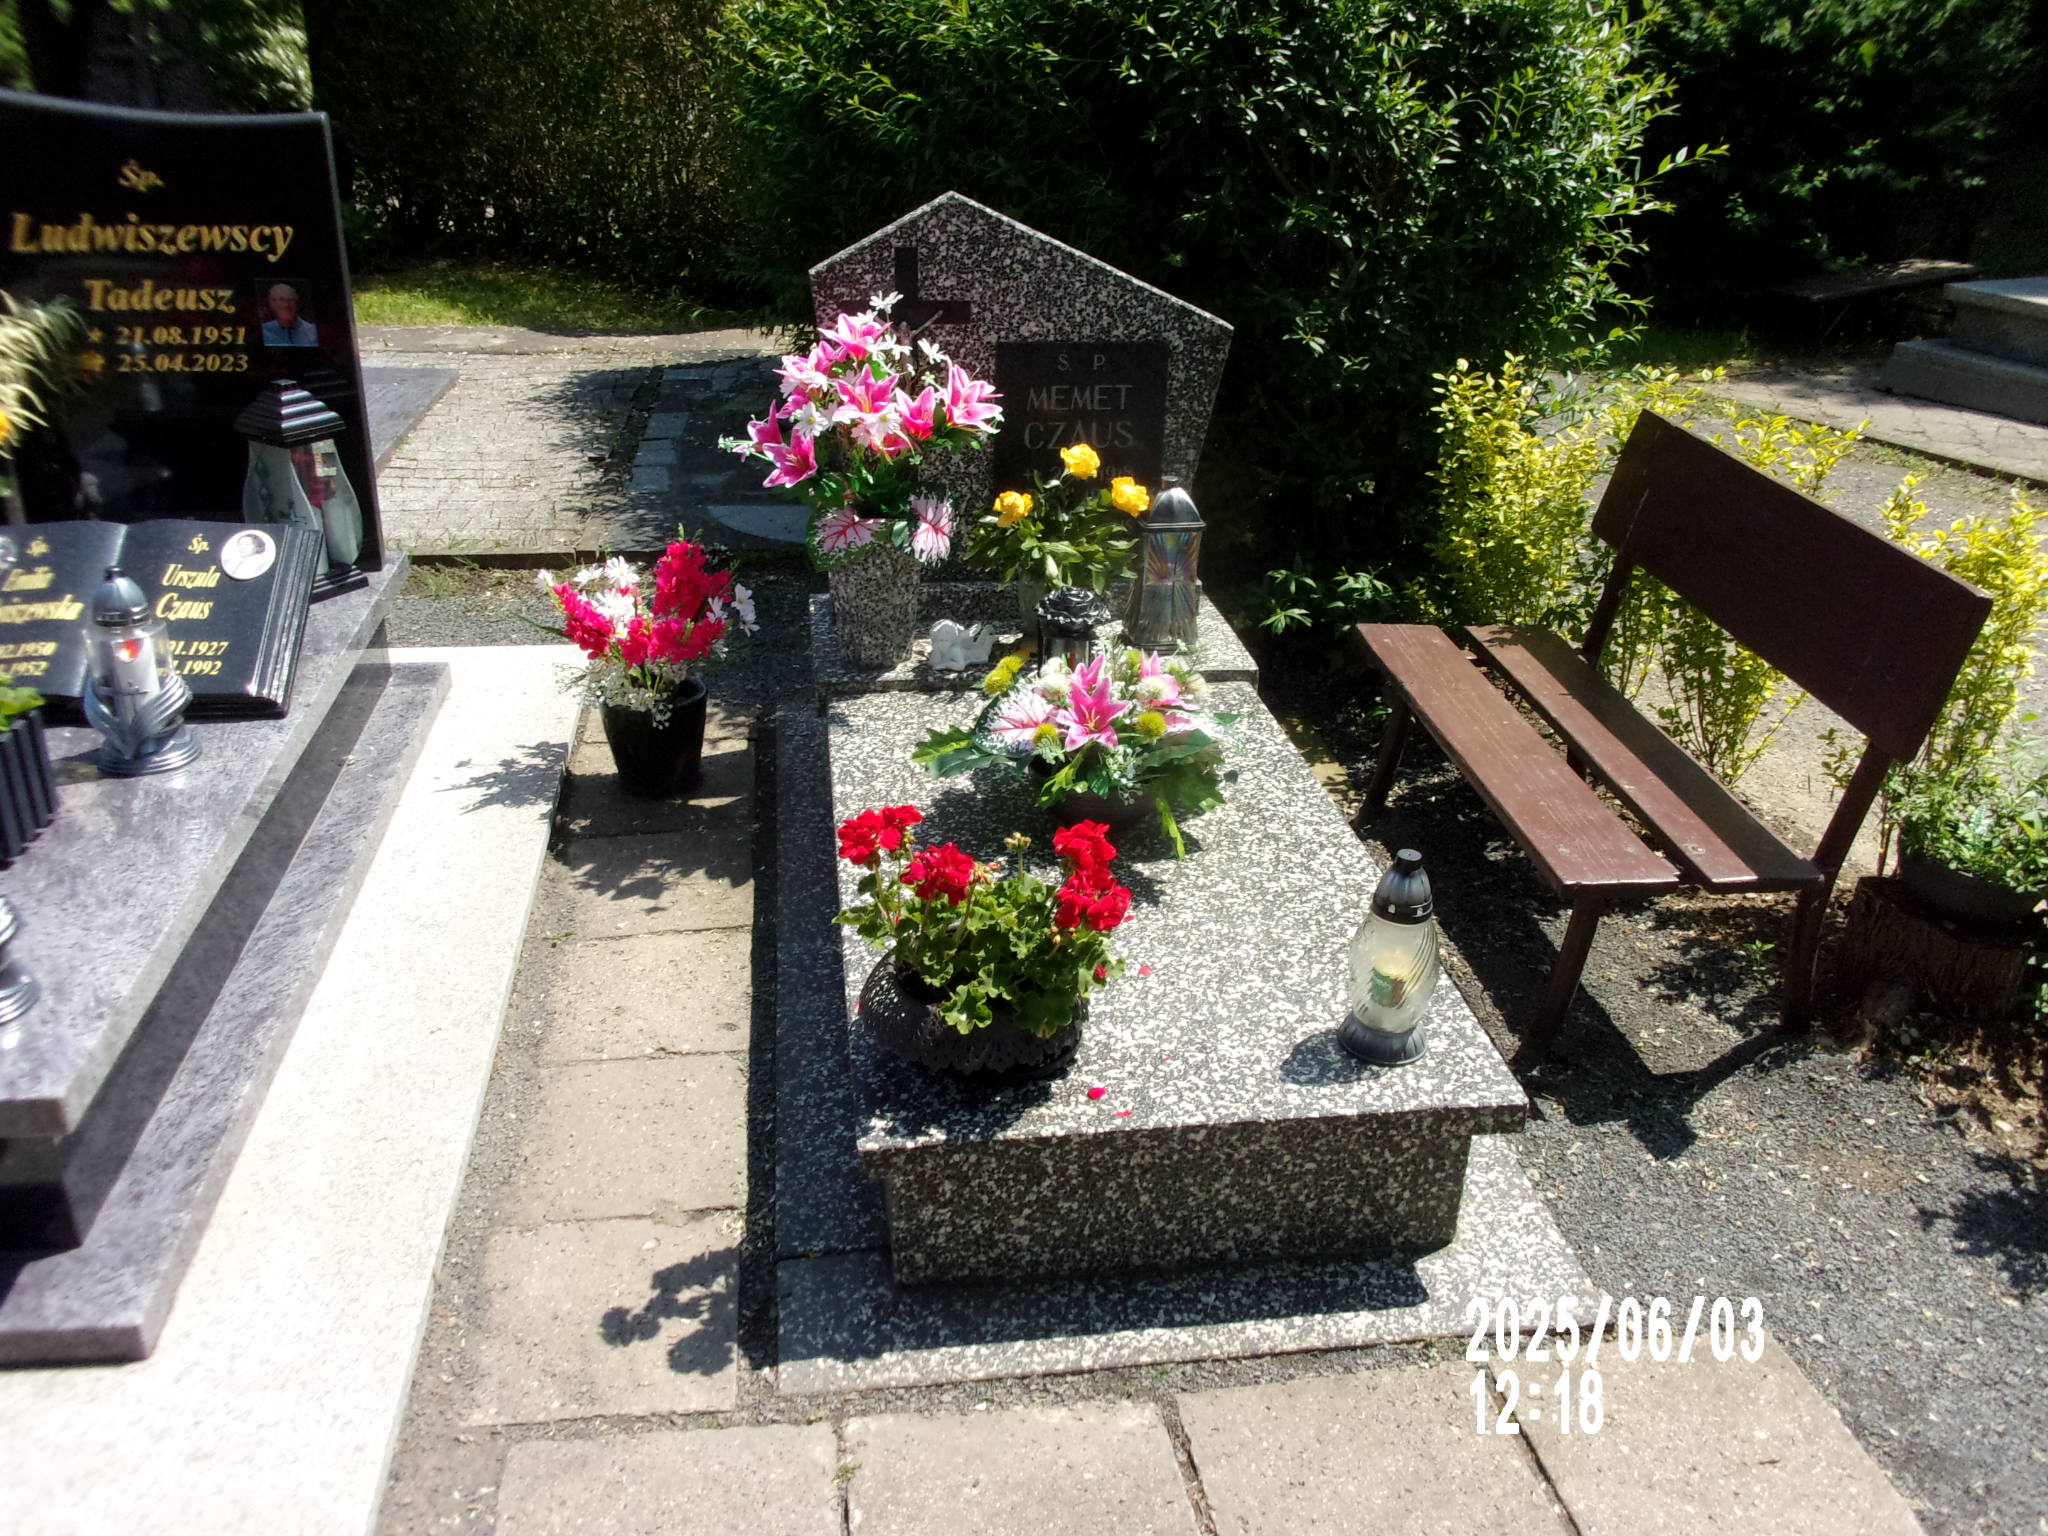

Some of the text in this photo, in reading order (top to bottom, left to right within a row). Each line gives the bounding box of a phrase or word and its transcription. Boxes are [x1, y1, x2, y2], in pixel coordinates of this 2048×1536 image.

[11, 211, 294, 263] Ludwiszewscy
[84, 278, 236, 314] Tadeusz
[115, 326, 246, 345] 21.08.1951
[117, 353, 249, 372] 25.04.2023
[1026, 384, 1133, 411] MEMET
[1023, 420, 1135, 449] CZAUS
[188, 533, 210, 554] Śp.
[162, 563, 222, 590] Urszula
[156, 592, 213, 621] Czaus
